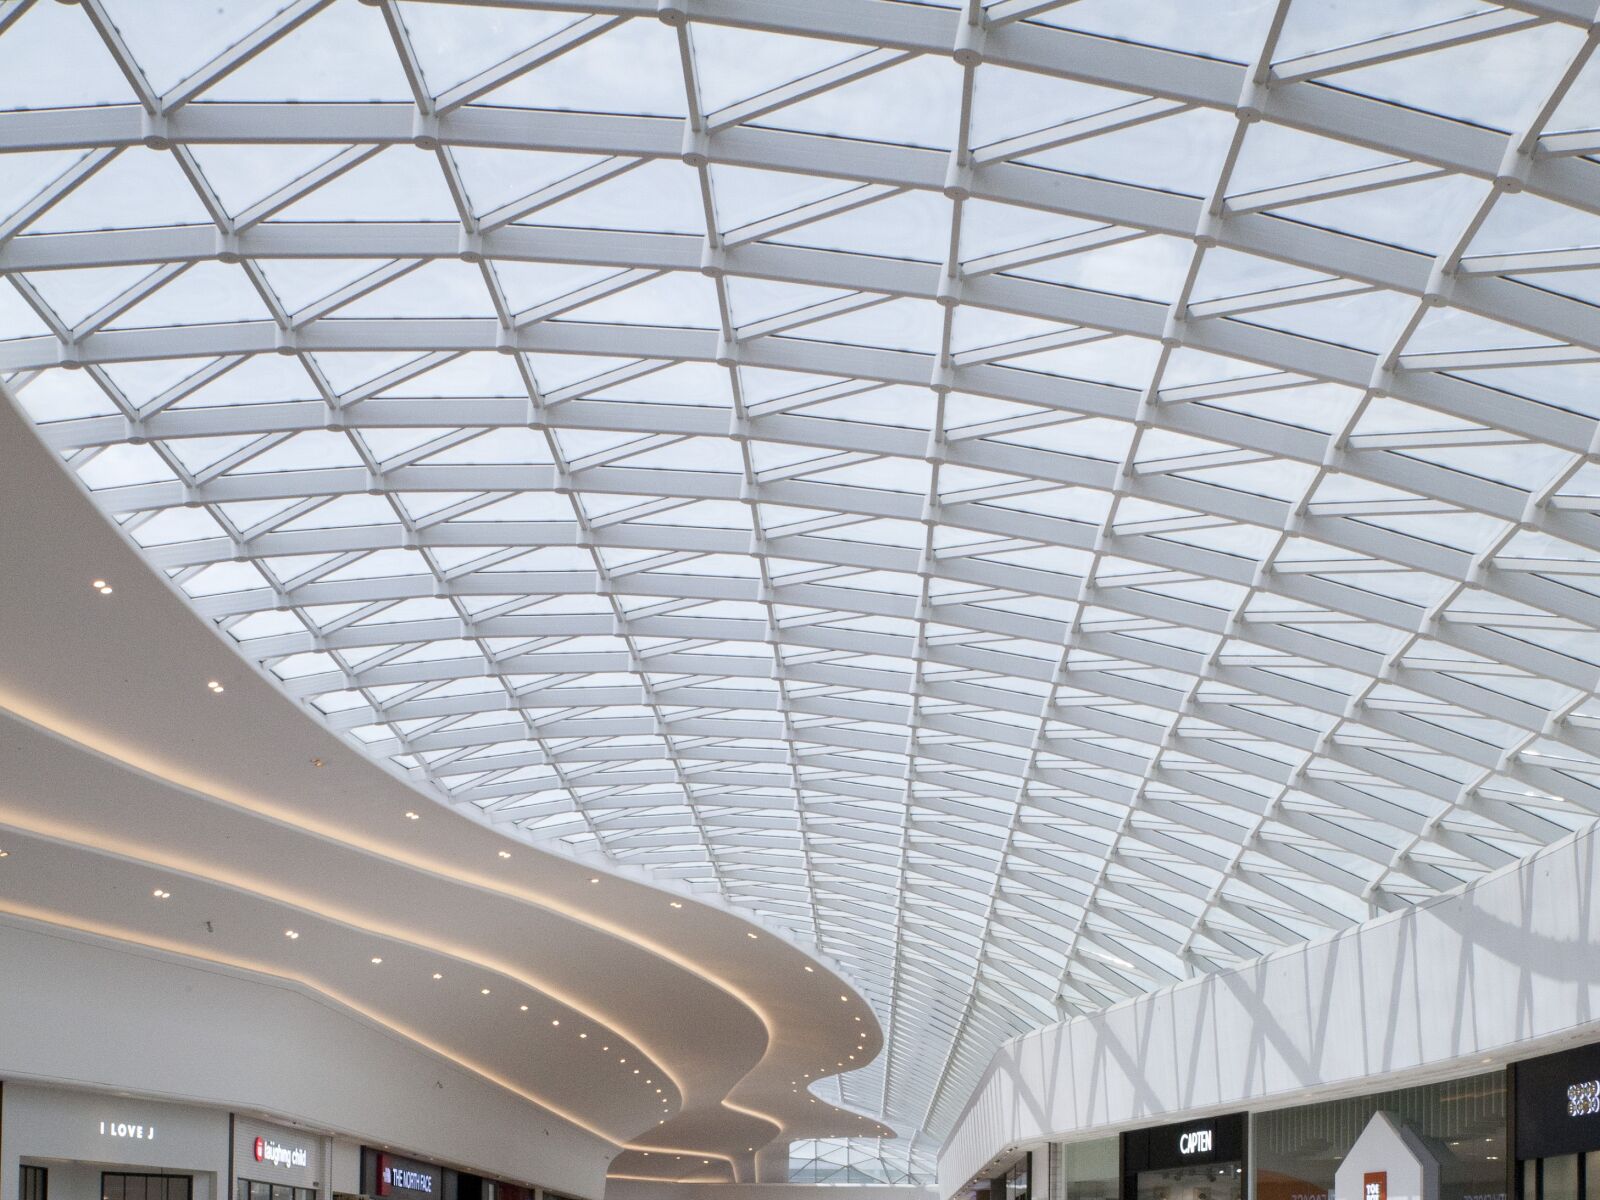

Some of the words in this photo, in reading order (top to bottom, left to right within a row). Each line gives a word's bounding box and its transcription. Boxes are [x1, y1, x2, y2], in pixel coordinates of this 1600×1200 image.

[100, 1121, 105, 1135] I
[110, 1123, 143, 1139] LOVE
[147, 1127, 154, 1140] J
[1180, 1129, 1212, 1155] CAPTEN
[291, 1147, 306, 1167] child
[392, 1168, 403, 1188] THE
[403, 1170, 420, 1191] NORTH
[420, 1174, 432, 1193] FACE
[1366, 1183, 1379, 1194] TOE
